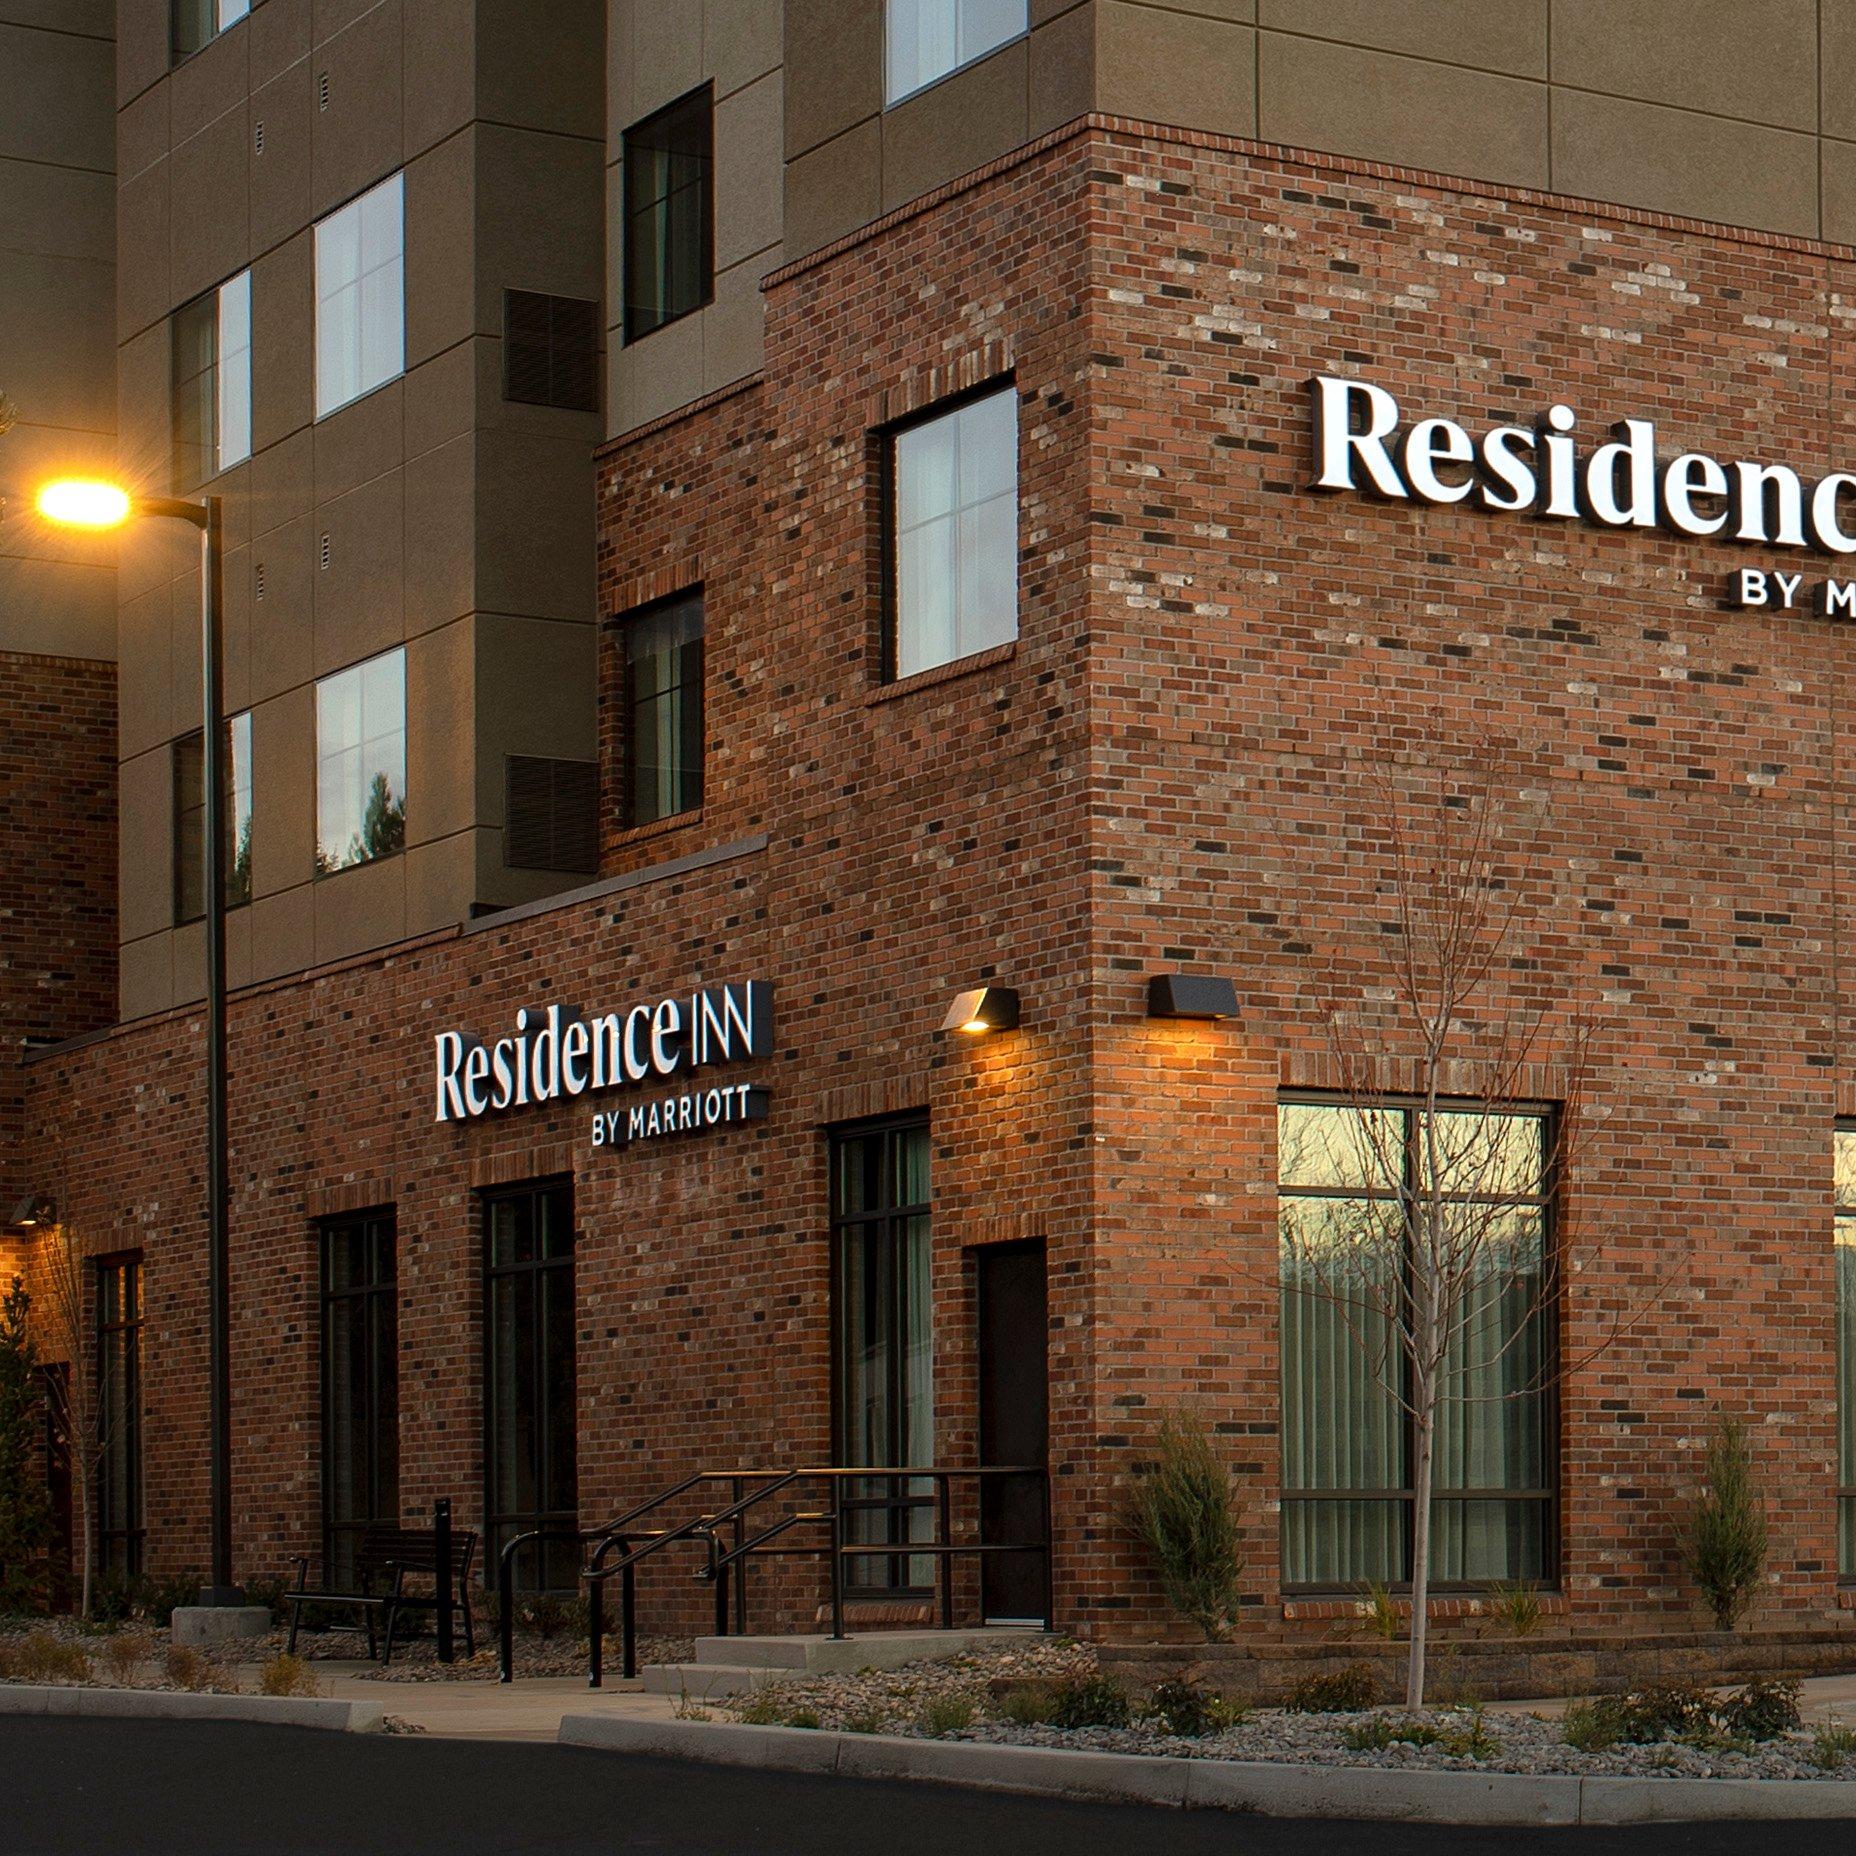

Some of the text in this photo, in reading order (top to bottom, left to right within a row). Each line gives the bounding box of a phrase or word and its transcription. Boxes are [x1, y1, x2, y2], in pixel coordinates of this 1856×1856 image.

[1740, 568, 1802, 608] BY
[434, 979, 752, 1122] Residence INN
[592, 1084, 751, 1146] BY MARRIOTT
